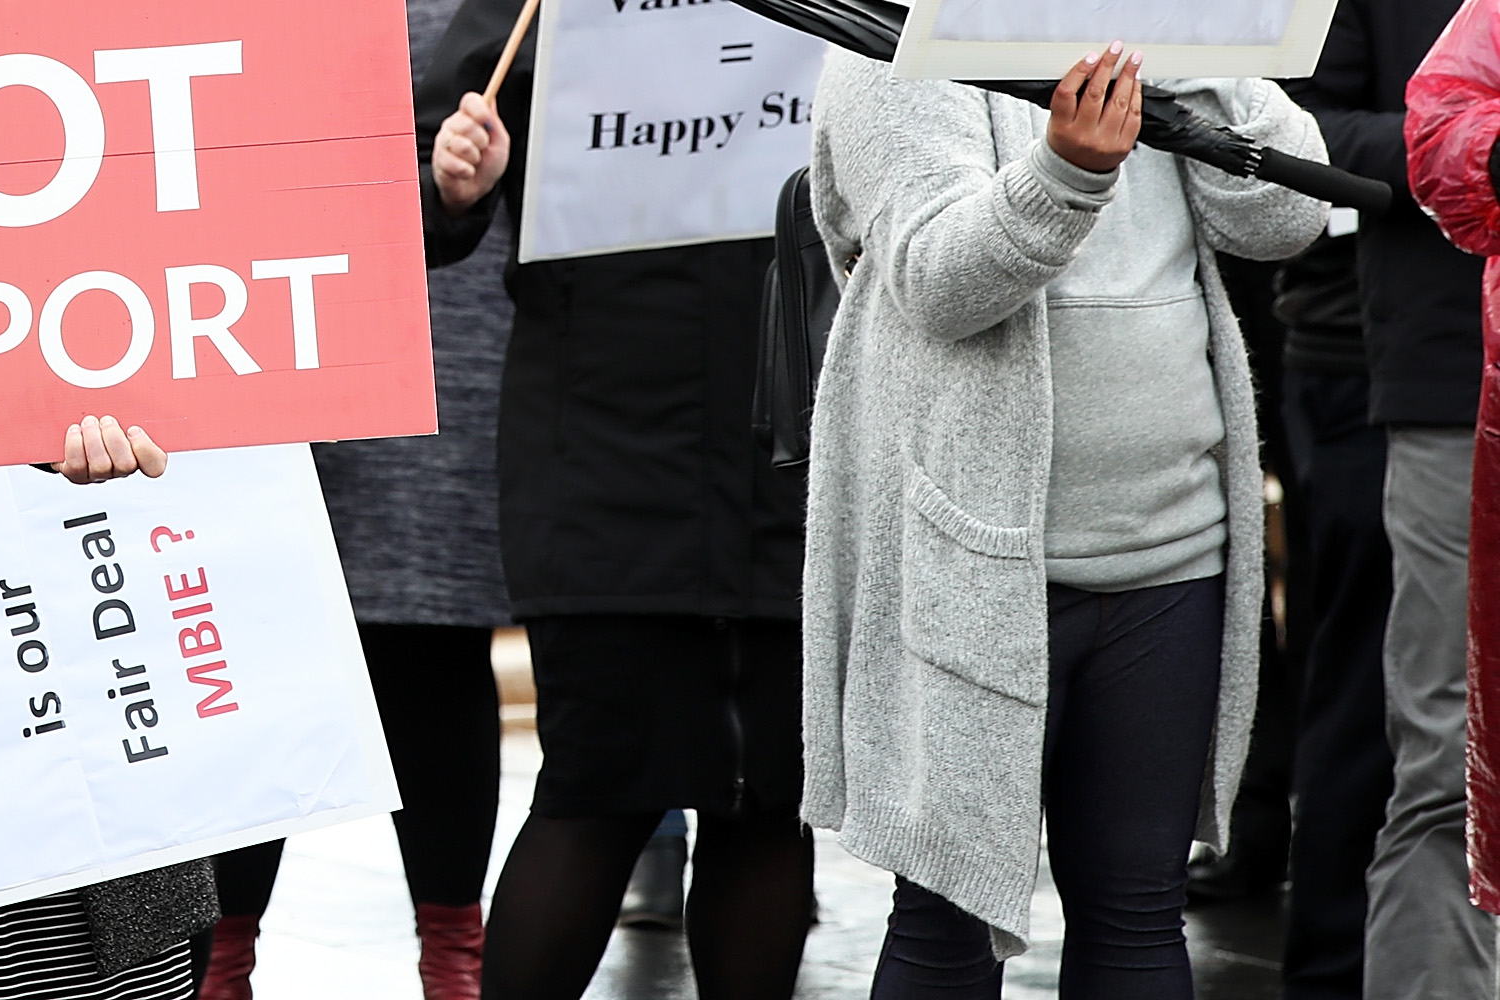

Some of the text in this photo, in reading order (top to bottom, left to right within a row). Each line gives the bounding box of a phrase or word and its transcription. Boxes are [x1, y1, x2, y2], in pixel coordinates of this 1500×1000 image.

[588, 111, 744, 157] Happy
[63, 511, 169, 764] Fair Deal
[164, 566, 240, 720] MBIE
[23, 691, 66, 738] is
